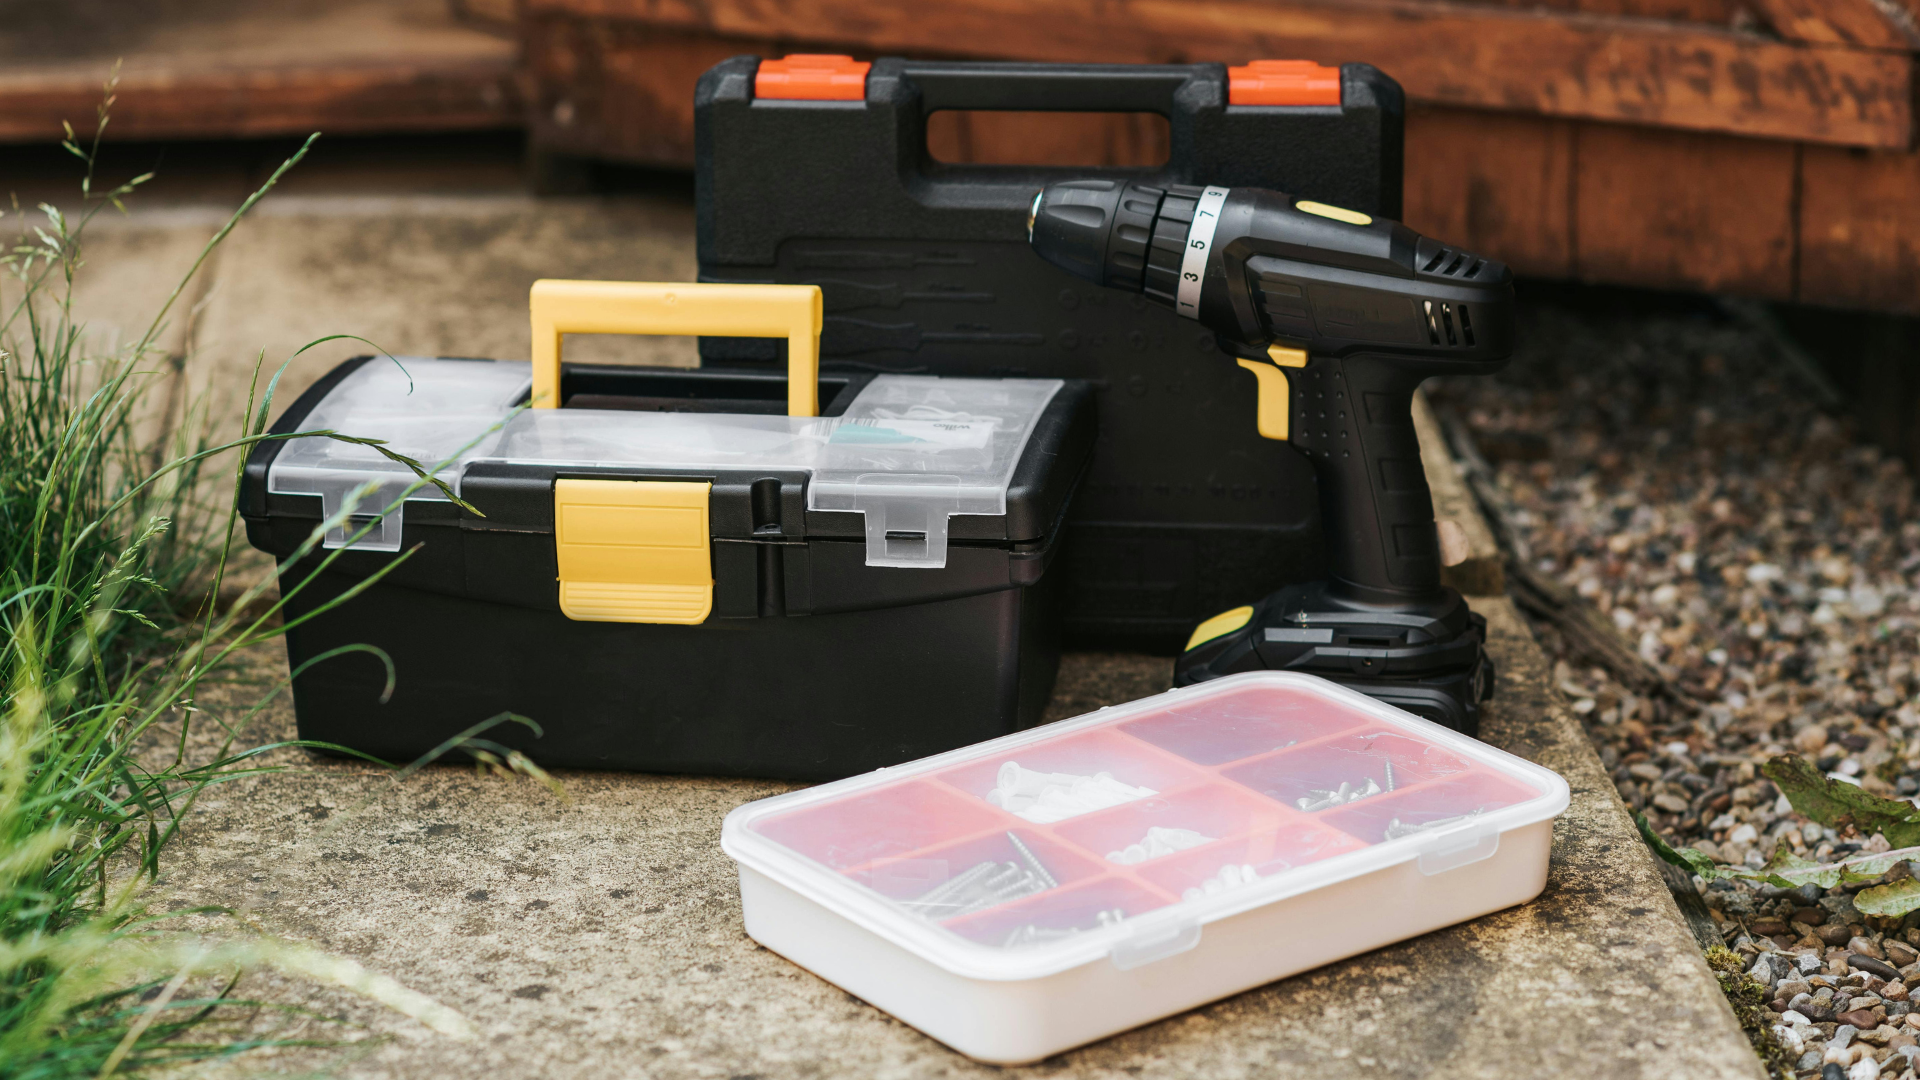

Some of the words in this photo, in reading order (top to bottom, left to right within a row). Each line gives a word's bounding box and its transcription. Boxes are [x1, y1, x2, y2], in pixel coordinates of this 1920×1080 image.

[1184, 272, 1198, 282] 3
[1191, 240, 1205, 249] 5
[1199, 210, 1214, 218] 7
[933, 423, 970, 431] wilko
